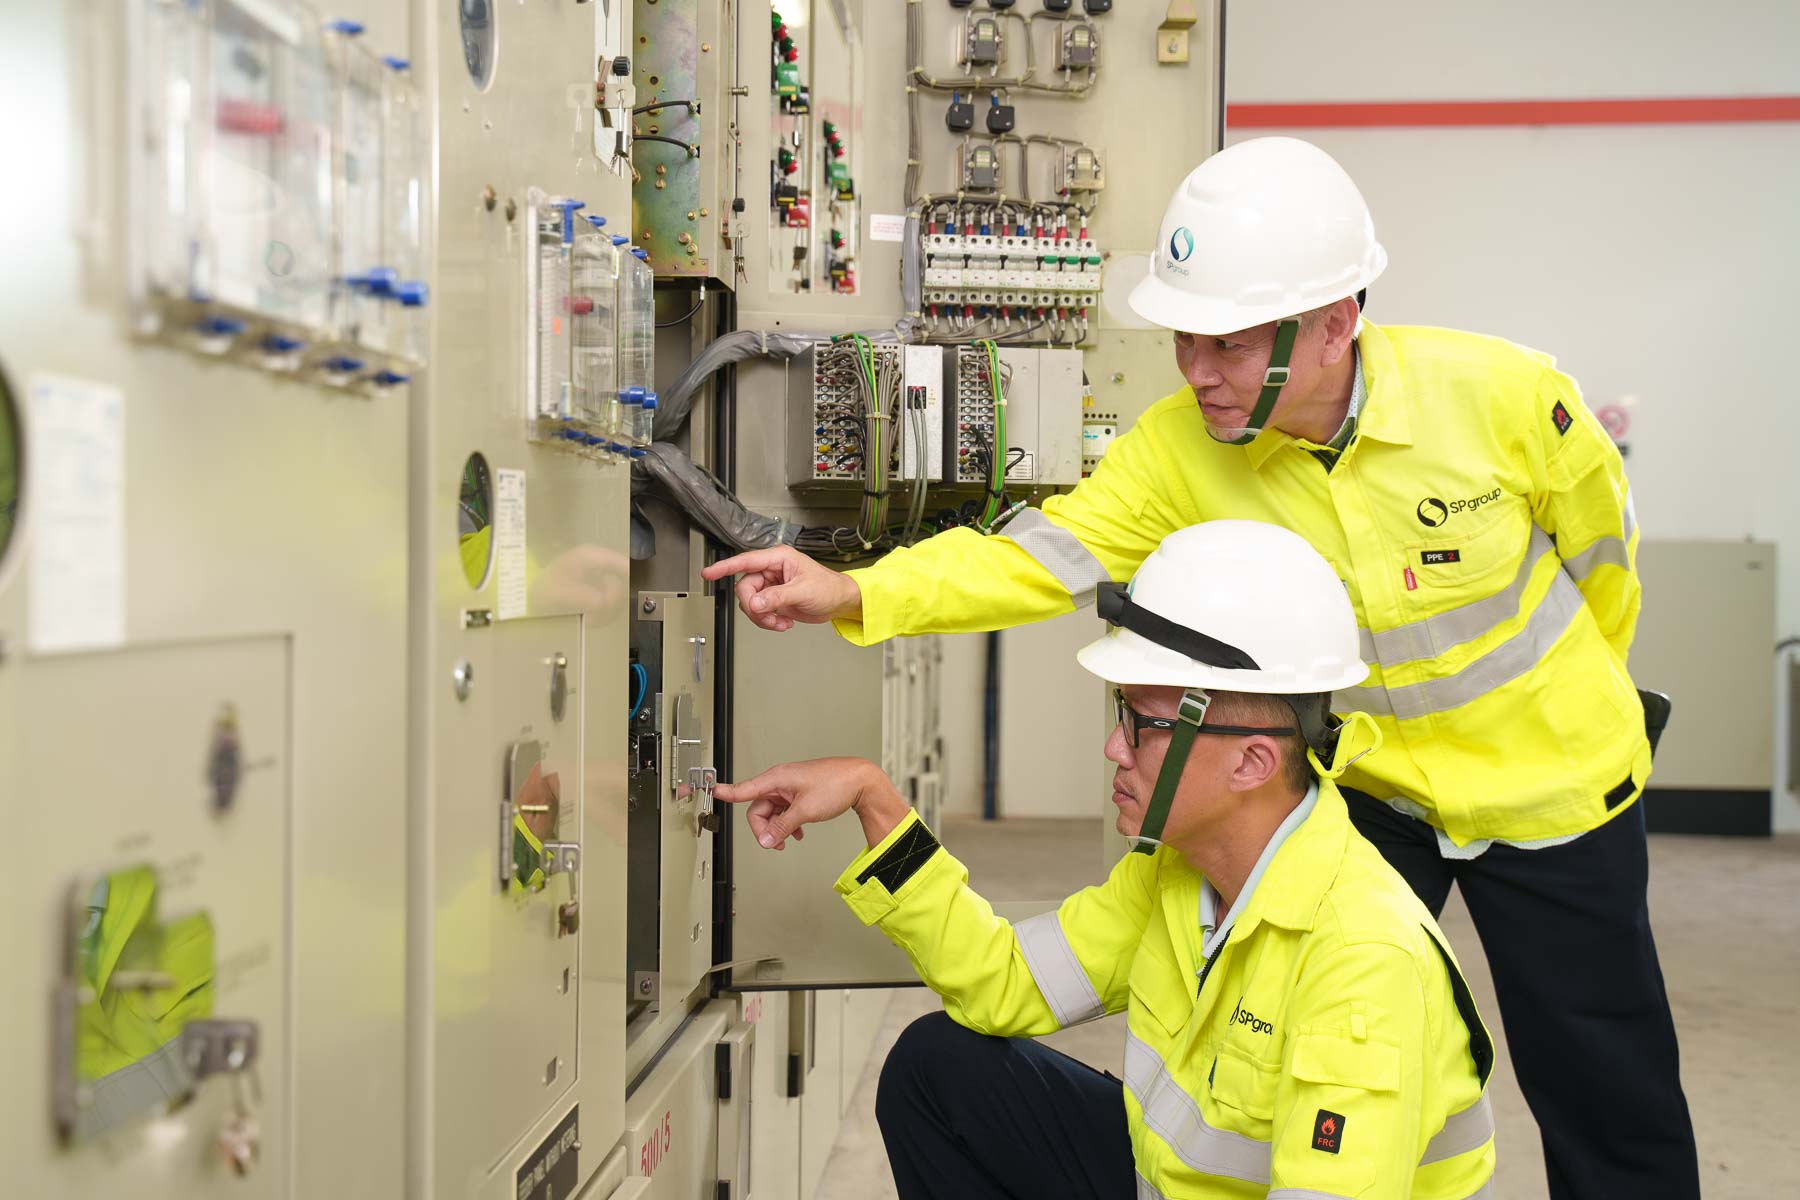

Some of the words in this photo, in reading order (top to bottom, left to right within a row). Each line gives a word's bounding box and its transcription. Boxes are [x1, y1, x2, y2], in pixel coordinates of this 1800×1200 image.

[1449, 487, 1502, 514] SPgroup
[1426, 553, 1444, 562] PPE
[1447, 552, 1455, 561] 2
[1317, 1137, 1335, 1148] FRC
